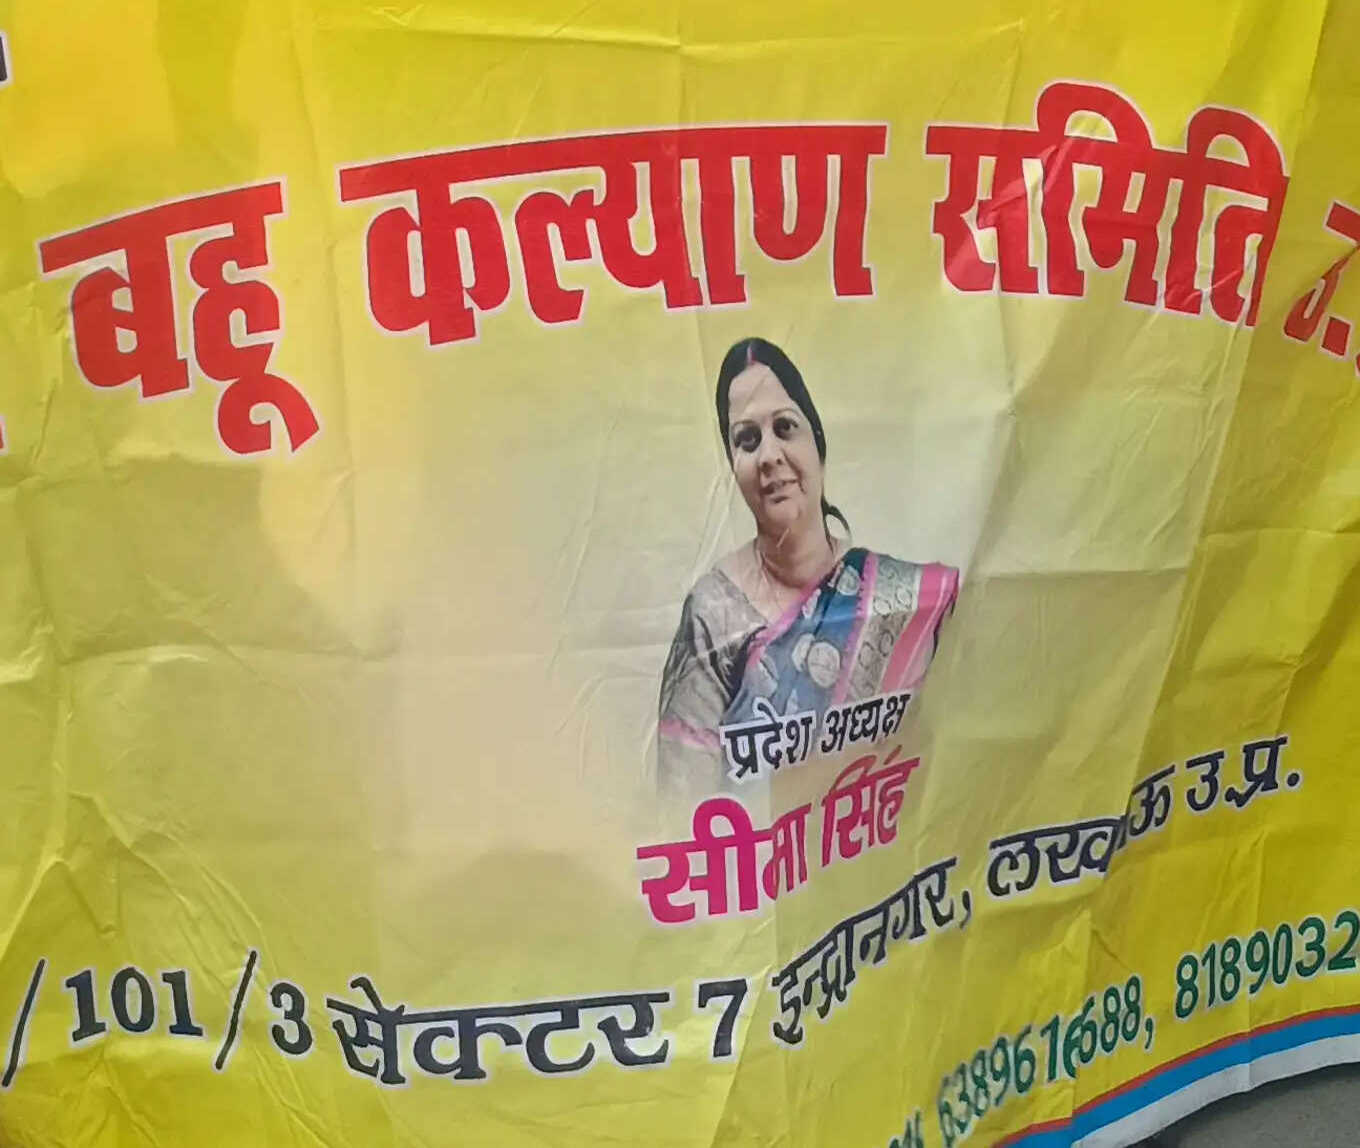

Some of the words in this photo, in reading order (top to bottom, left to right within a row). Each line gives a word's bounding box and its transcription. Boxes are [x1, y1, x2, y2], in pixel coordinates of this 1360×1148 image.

[40, 181, 321, 454] बहू
[339, 124, 887, 346] कल्याण
[926, 82, 1289, 327] समिति
[637, 798, 812, 924] सीमा
[820, 744, 920, 868] सिंह
[724, 702, 813, 779] प्रदेश
[821, 693, 911, 755] अध्यक्ष
[326, 976, 670, 1085] सेक्टर
[698, 978, 748, 1058] 7
[771, 856, 971, 1045] इन्द्रानगर,
[1186, 736, 1300, 811] उ.प्र.
